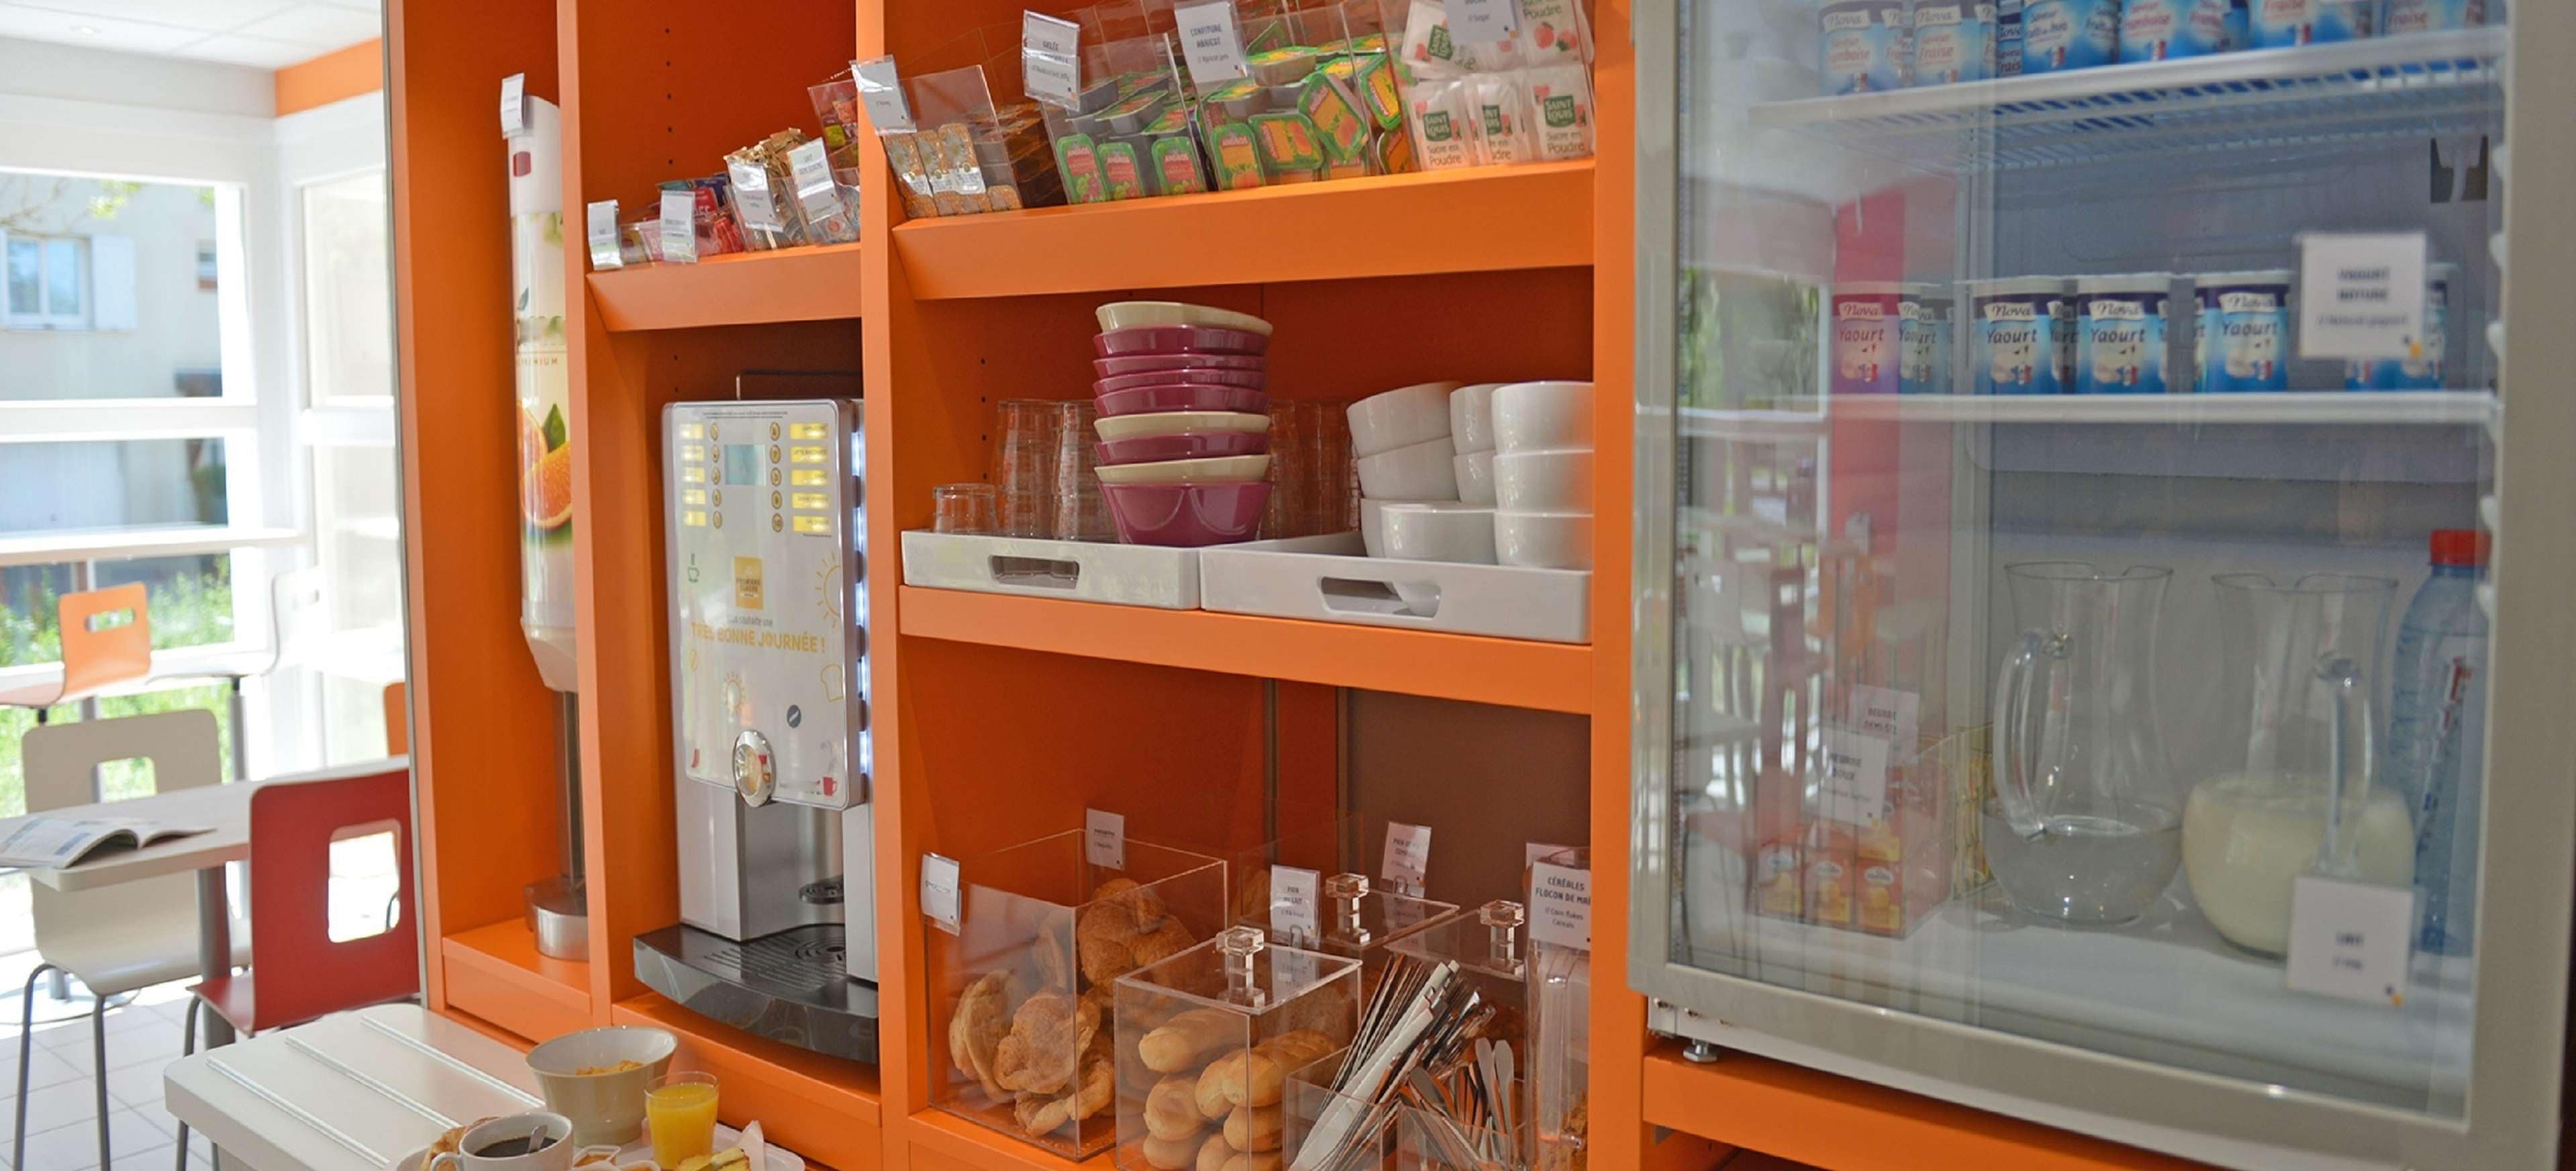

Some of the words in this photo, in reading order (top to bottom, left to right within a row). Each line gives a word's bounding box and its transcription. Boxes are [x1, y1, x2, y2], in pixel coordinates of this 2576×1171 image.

[1546, 99, 1571, 110] SAINT
[1547, 140, 1585, 154] Poudre
[1429, 154, 1462, 166] Poudre
[1844, 303, 1879, 316] Nova
[1991, 305, 2031, 317] Nova
[2096, 303, 2140, 316] Nova
[1839, 327, 1884, 342] Yaourt
[2090, 327, 2146, 344] Yaourt
[2222, 320, 2278, 336] Yaourt
[1987, 328, 2038, 344] Yaourt
[717, 626, 756, 647] BONNE
[758, 630, 818, 654] JOURNÉE
[1547, 876, 1585, 892] CÉRÉALES
[1535, 886, 1563, 900] FLOCON
[1565, 892, 1575, 902] DE
